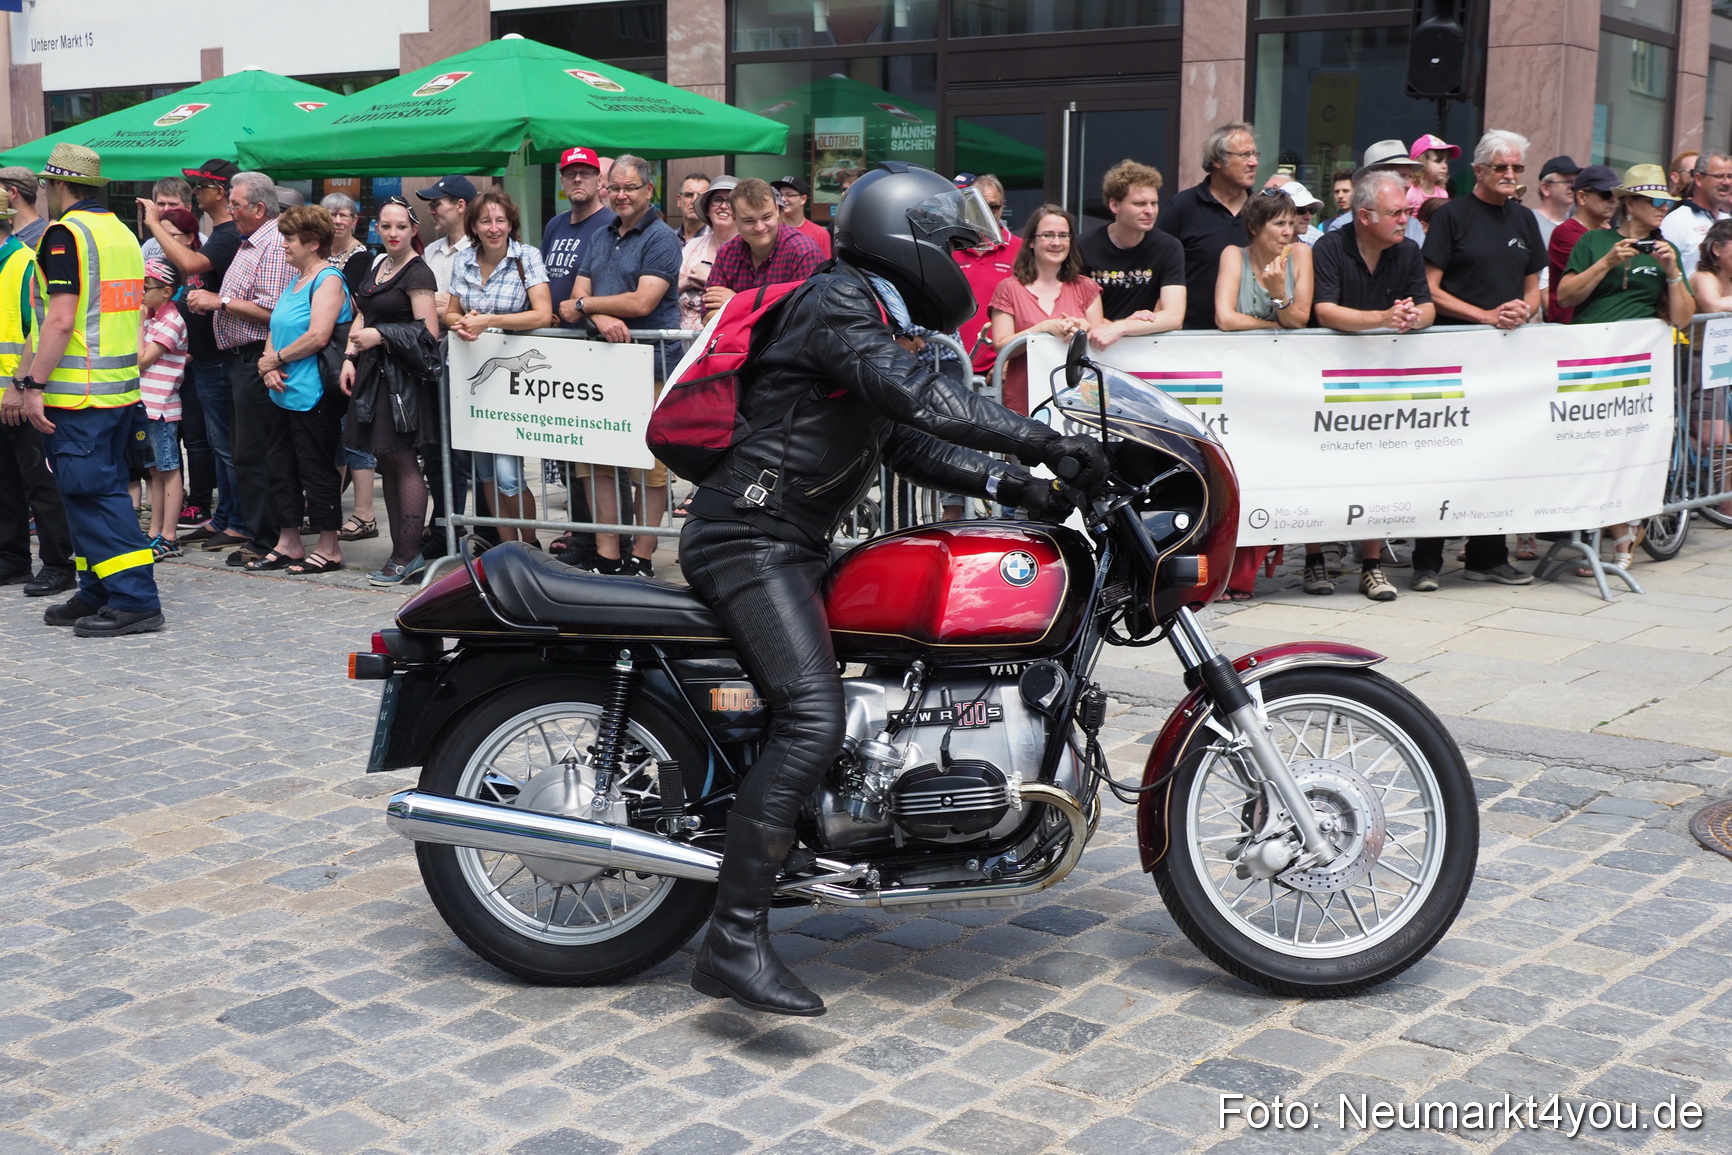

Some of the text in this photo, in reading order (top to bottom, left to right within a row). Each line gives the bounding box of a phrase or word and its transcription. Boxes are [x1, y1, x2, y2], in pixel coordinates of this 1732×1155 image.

[31, 32, 94, 52] Unterer Markt 15
[366, 98, 456, 112] Neumarkter
[331, 106, 457, 125] Lammsbräu
[111, 128, 188, 138] Neumarkter
[891, 122, 937, 139] MÄNNER
[81, 136, 187, 148] Lammsbräu
[818, 135, 861, 149] OLDTIMER
[551, 238, 581, 252] DEER
[509, 372, 605, 403] Express
[1549, 392, 1653, 422] NeuerMarkt
[470, 405, 632, 432] Interessengemeinschaft
[1314, 406, 1470, 432] NeuerMarkt
[516, 427, 584, 446] Neumarkt
[1556, 429, 1600, 441] einkaufen
[1320, 436, 1463, 451] einkaufen leben genießen
[1392, 502, 1412, 512] 500
[1452, 507, 1514, 521] NM-Neumarkt
[1273, 518, 1324, 529] 10-20 Uhr
